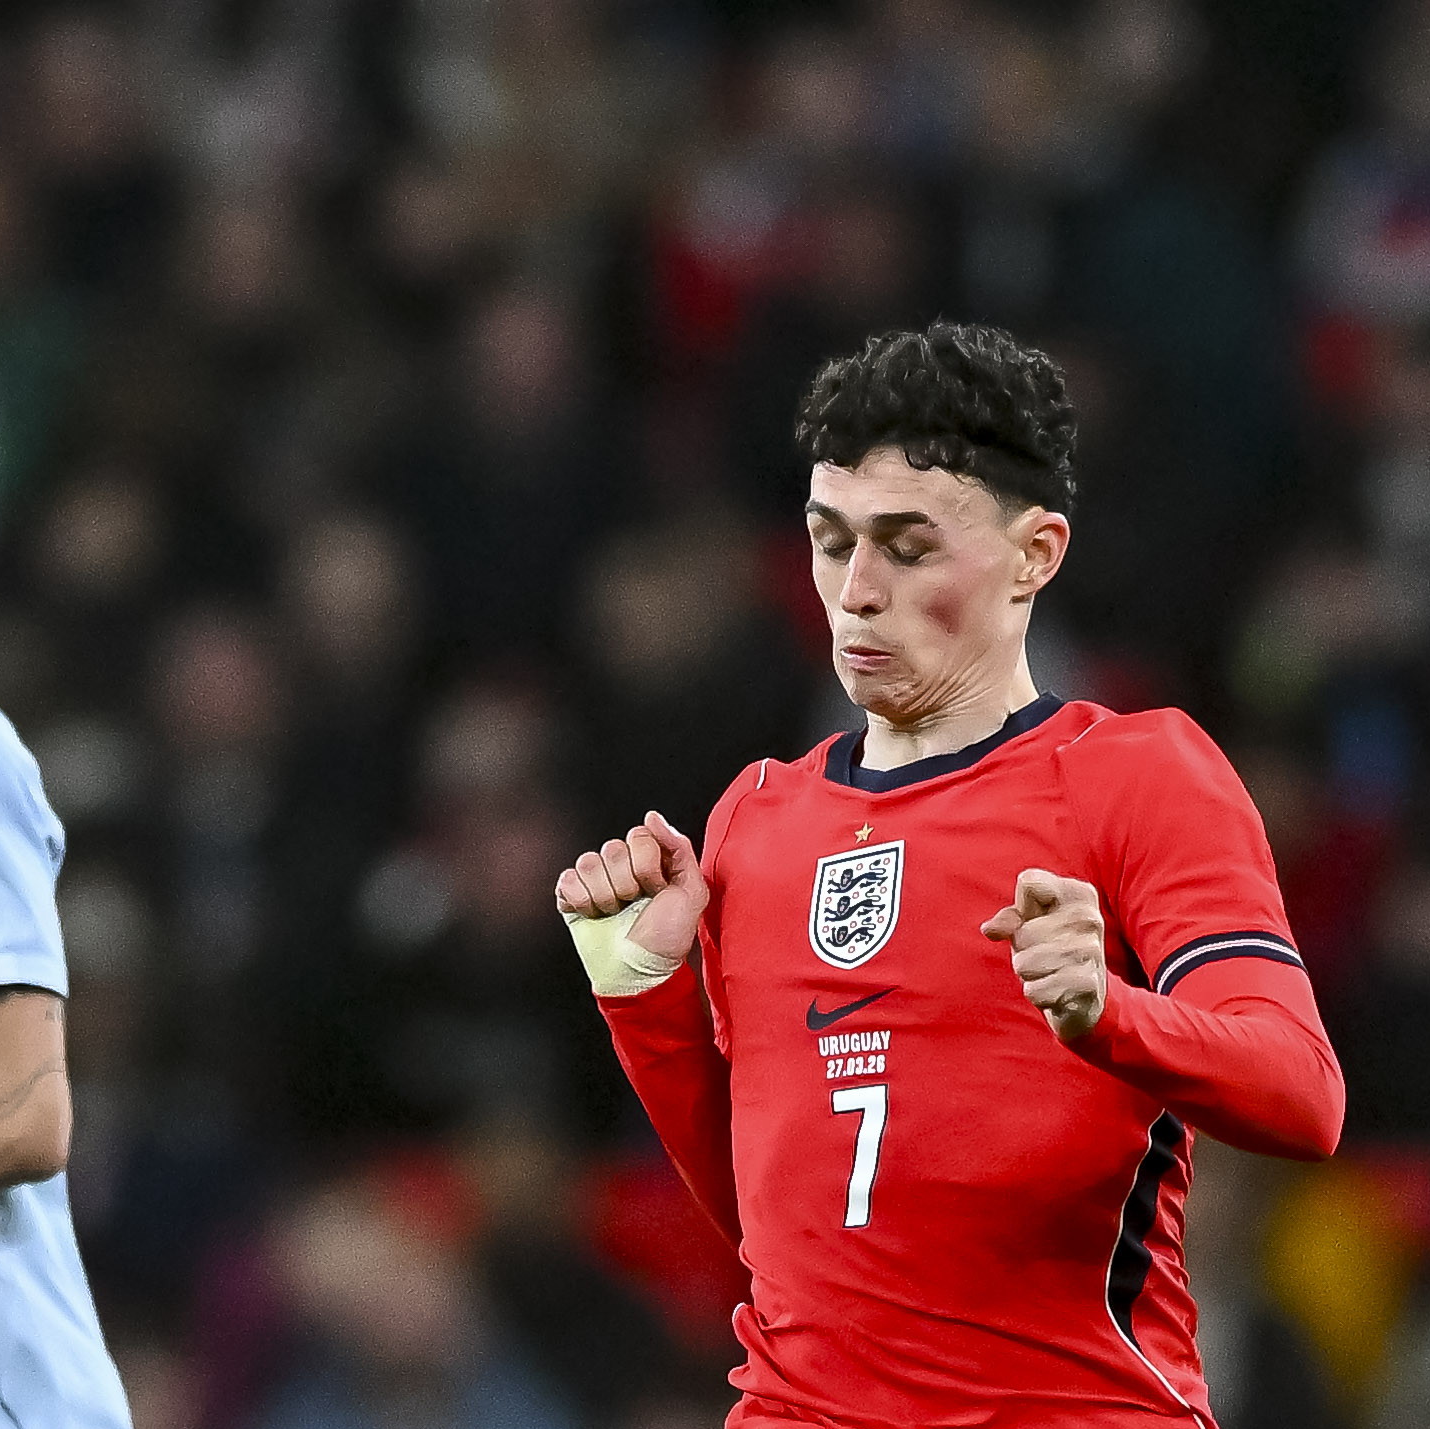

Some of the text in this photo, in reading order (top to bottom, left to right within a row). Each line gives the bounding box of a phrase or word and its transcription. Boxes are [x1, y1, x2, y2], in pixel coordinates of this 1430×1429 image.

[818, 1030, 891, 1057] URUGUAY
[826, 1054, 886, 1079] 27.03.26
[831, 1084, 889, 1229] 7
